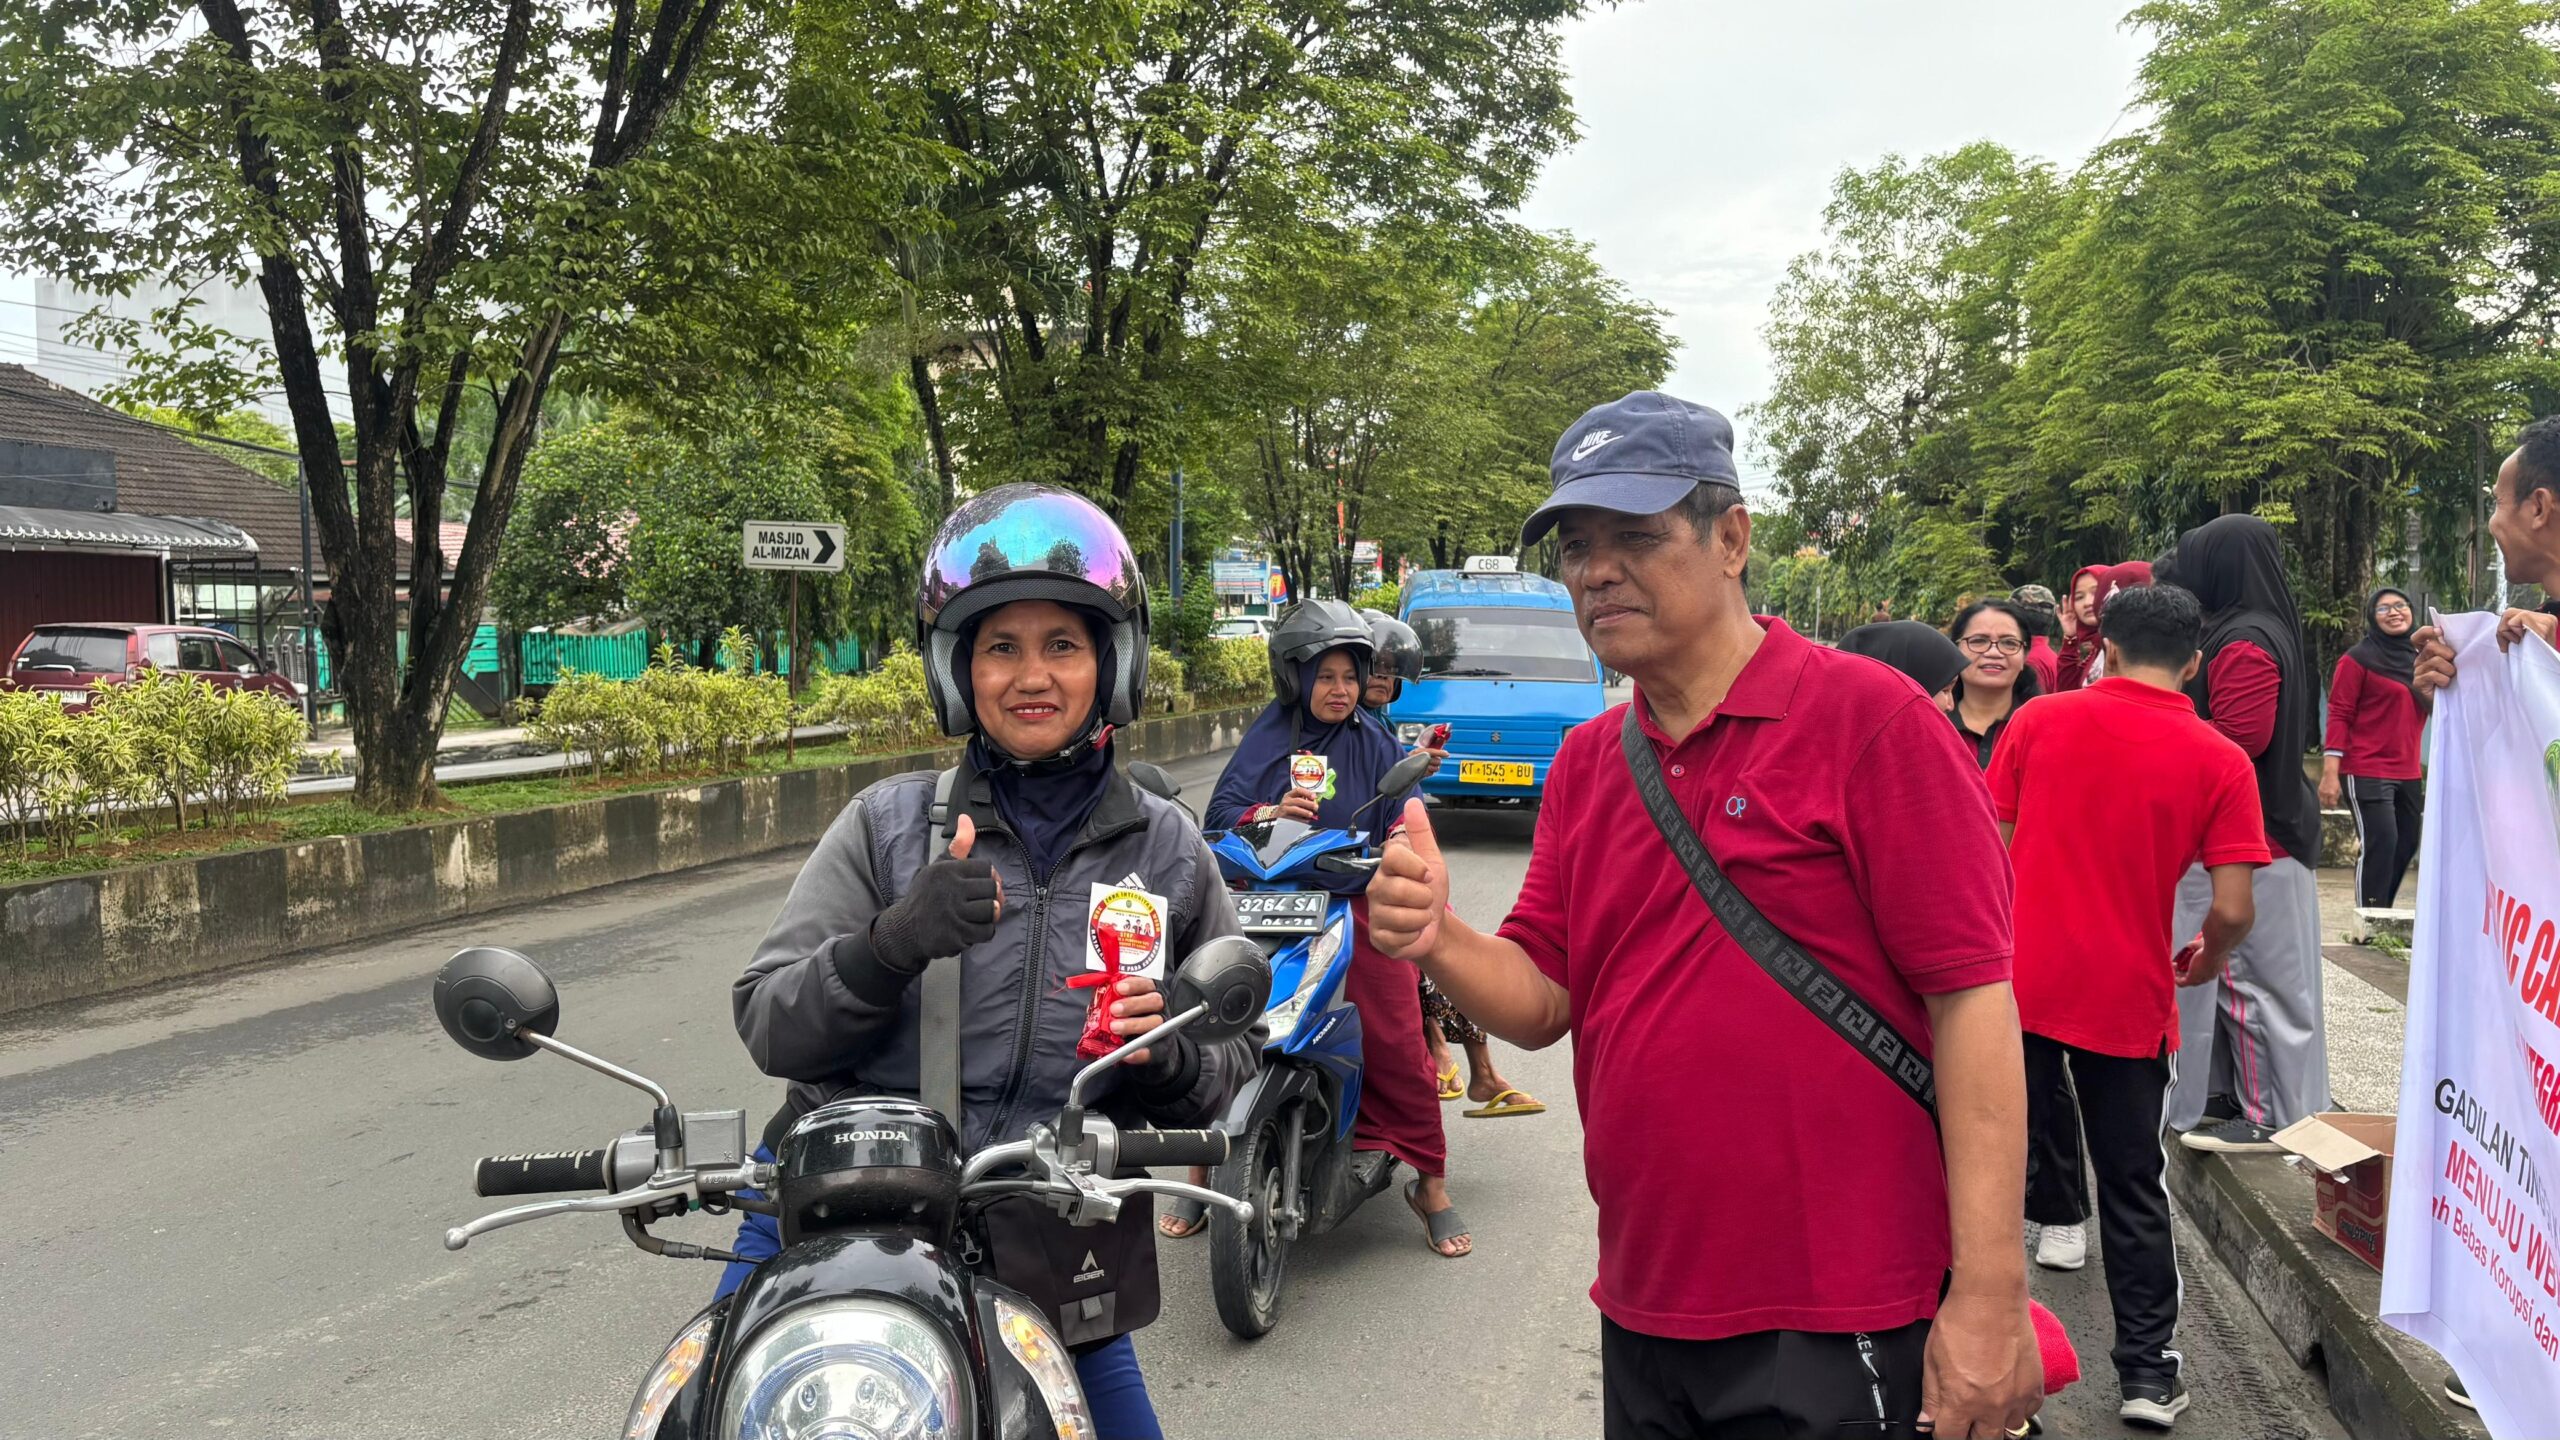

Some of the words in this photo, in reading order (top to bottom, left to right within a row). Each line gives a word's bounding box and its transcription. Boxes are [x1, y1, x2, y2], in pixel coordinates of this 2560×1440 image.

[1580, 430, 1612, 449] NIKE
[758, 531, 804, 545] MASJID
[752, 546, 810, 560] AL-MIZAN
[1478, 559, 1499, 570] C68
[1461, 762, 1474, 775] KT
[1482, 764, 1505, 776] 1545
[1517, 765, 1531, 777] BU
[1238, 897, 1287, 912] 3264
[1293, 897, 1317, 912] SA
[1312, 1017, 1337, 1045] HONDA
[2435, 1078, 2515, 1174] GADILAN
[832, 1130, 911, 1145] HONDA
[2445, 1140, 2525, 1253] MENUJU
[2453, 1207, 2487, 1267] Bebas
[2490, 1249, 2534, 1328] Korupsi
[2534, 1313, 2559, 1362] dan
